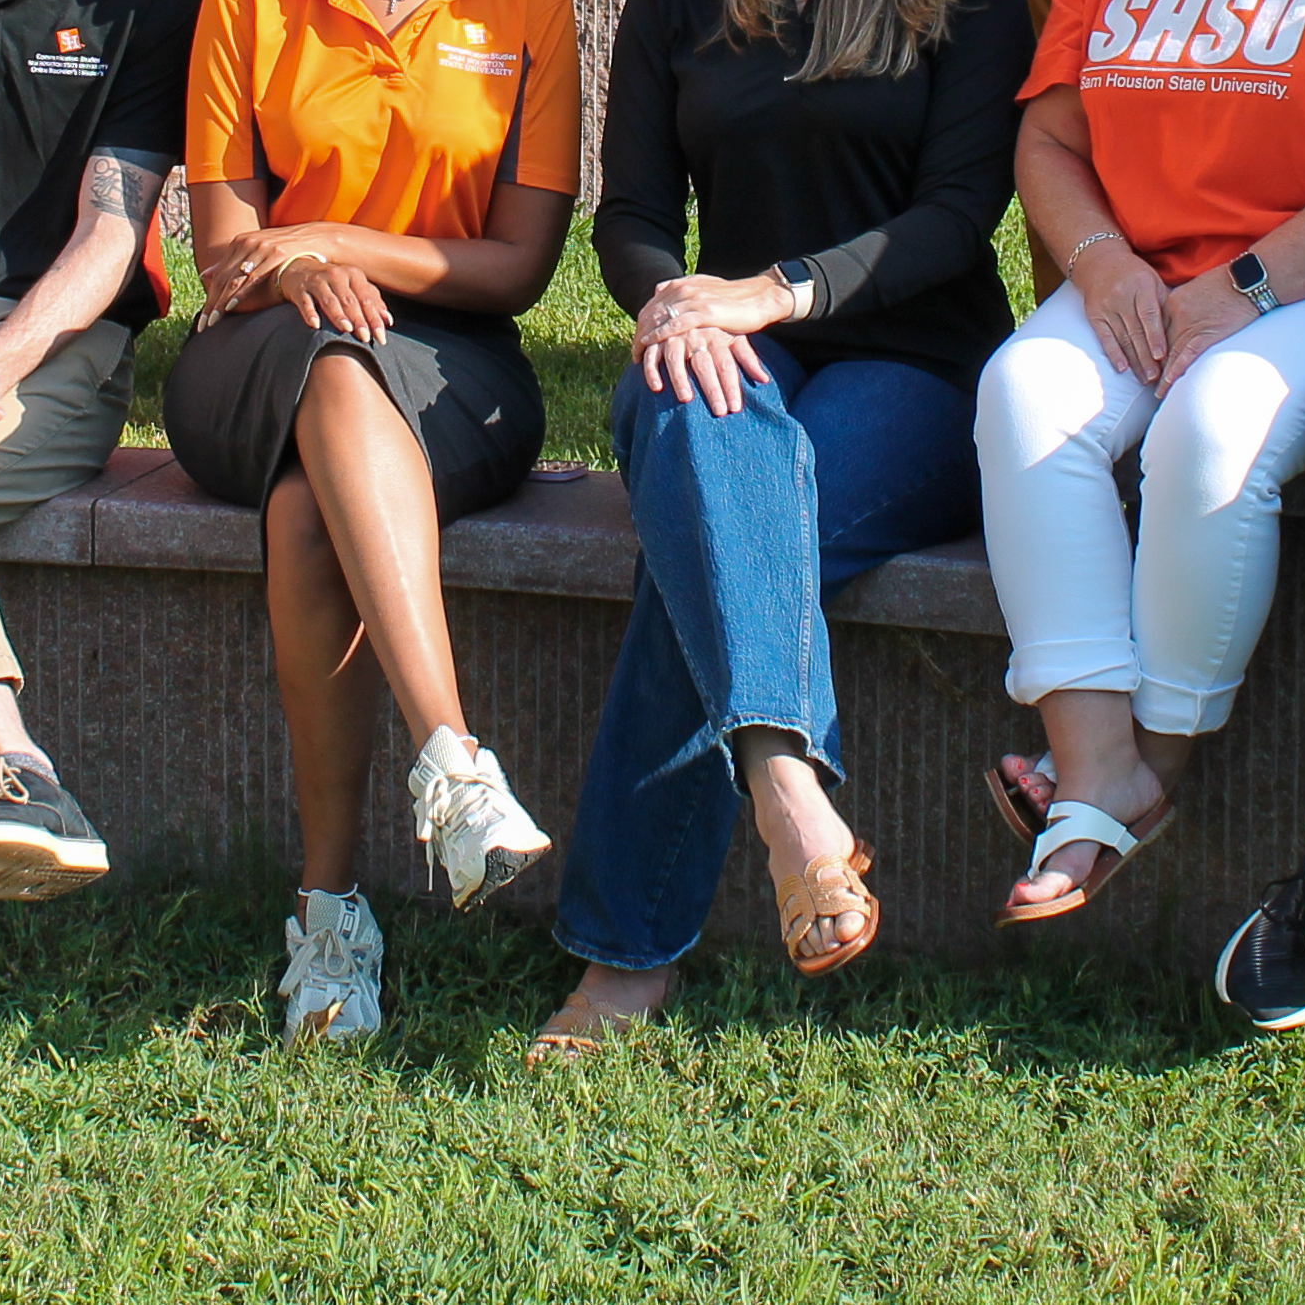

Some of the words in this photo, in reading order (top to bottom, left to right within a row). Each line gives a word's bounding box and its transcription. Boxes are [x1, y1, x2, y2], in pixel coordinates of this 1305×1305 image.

[1080, 74, 1102, 91] Sam
[1106, 73, 1164, 90] Houston
[1168, 75, 1206, 92] State
[1211, 77, 1288, 100] University
